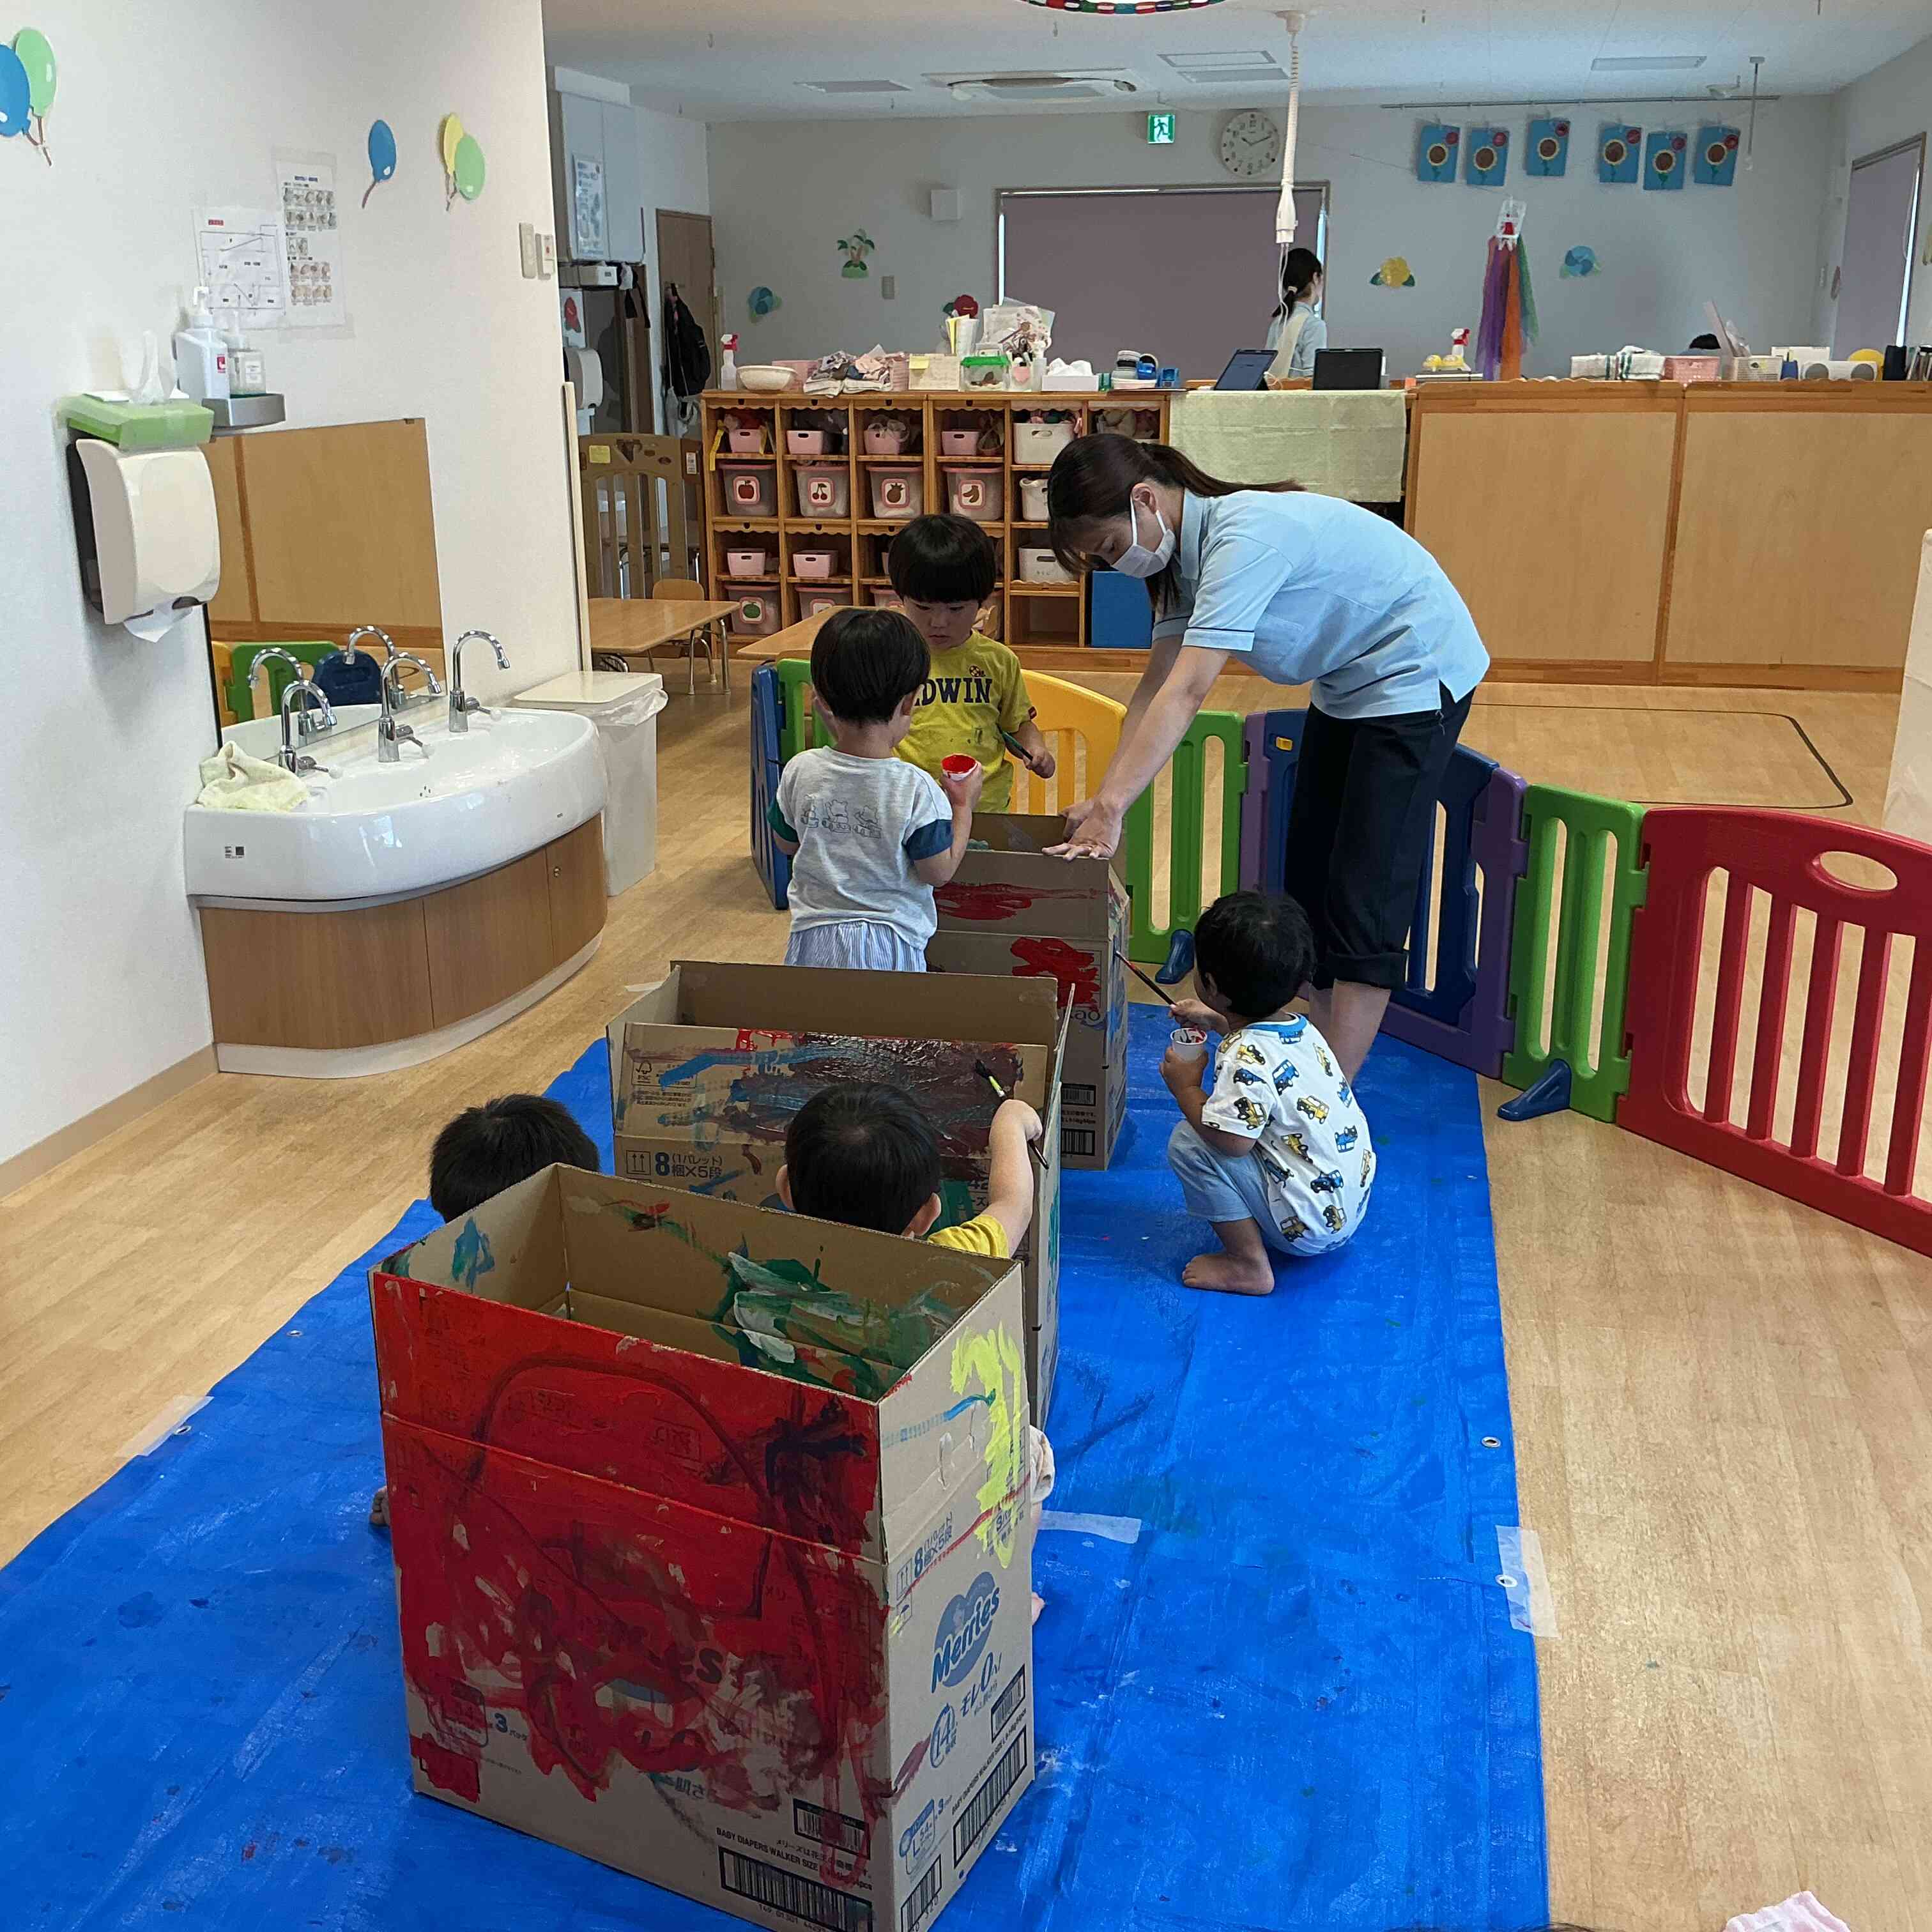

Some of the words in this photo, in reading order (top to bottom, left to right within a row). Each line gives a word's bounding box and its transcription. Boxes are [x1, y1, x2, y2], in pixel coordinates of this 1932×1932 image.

[914, 678, 992, 706] DWIN
[655, 1152, 670, 1176] 8
[914, 1547, 923, 1577] 8
[931, 1587, 999, 1693] Merries
[716, 1827, 735, 1840] BABY
[737, 1835, 768, 1853] DIAPERS
[769, 1846, 801, 1864] WALKER
[802, 1859, 818, 1871] SIZE
